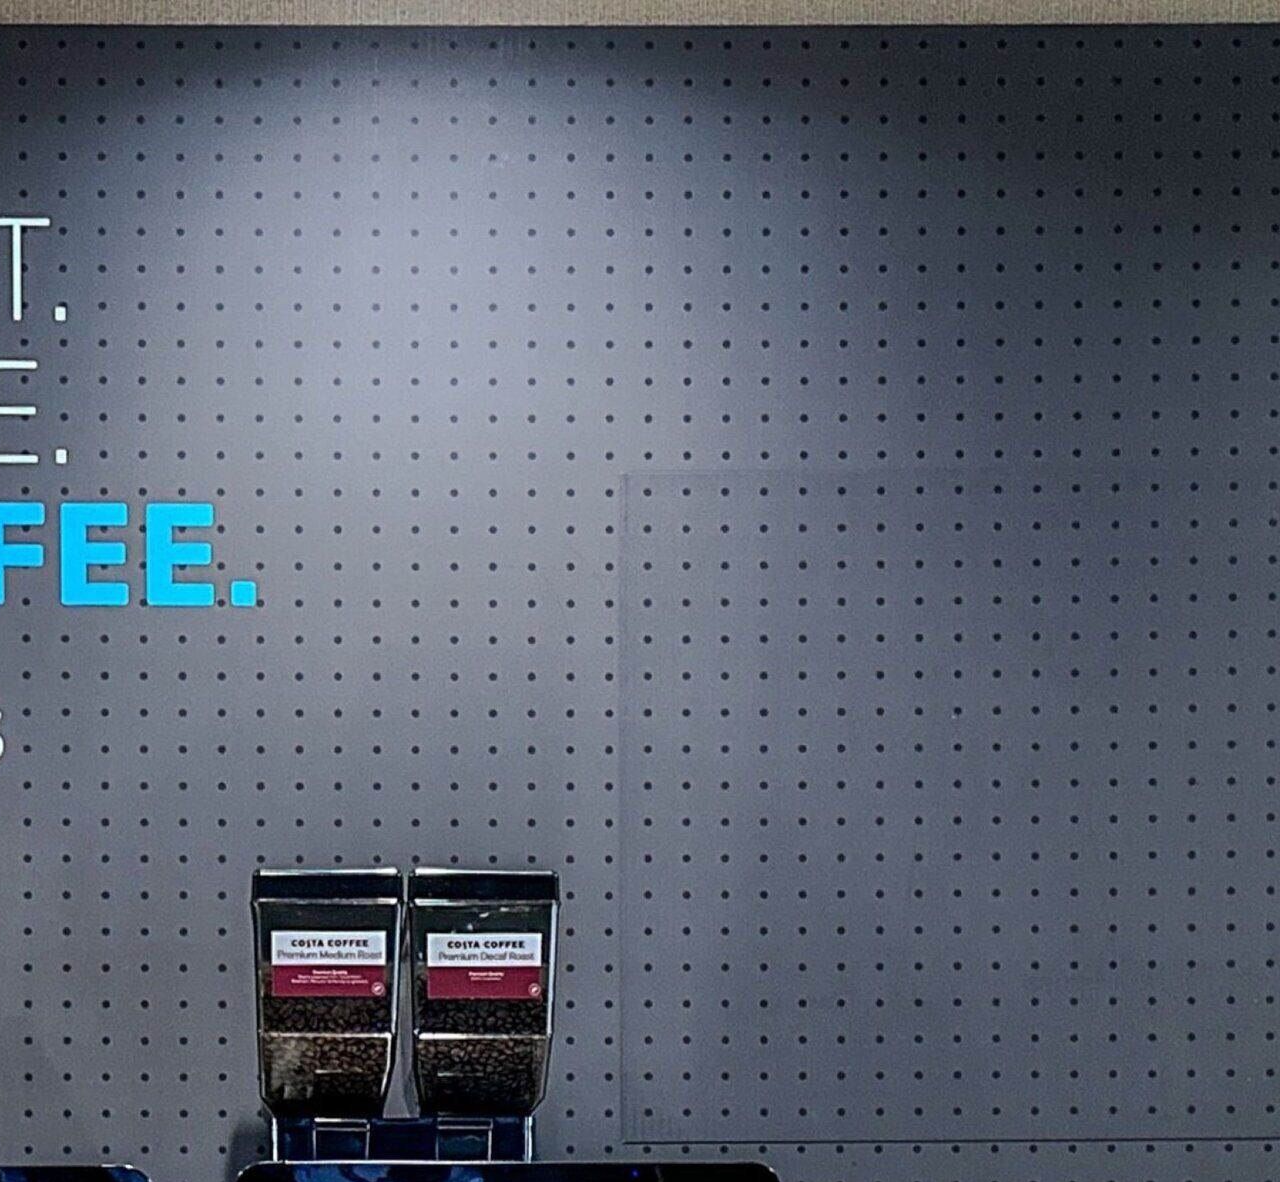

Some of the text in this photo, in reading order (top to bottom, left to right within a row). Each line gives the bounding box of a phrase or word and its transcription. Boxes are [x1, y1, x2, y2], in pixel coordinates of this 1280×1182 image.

[291, 939, 369, 948] COSTA COFFEE
[447, 940, 526, 949] COSTA COFFEE
